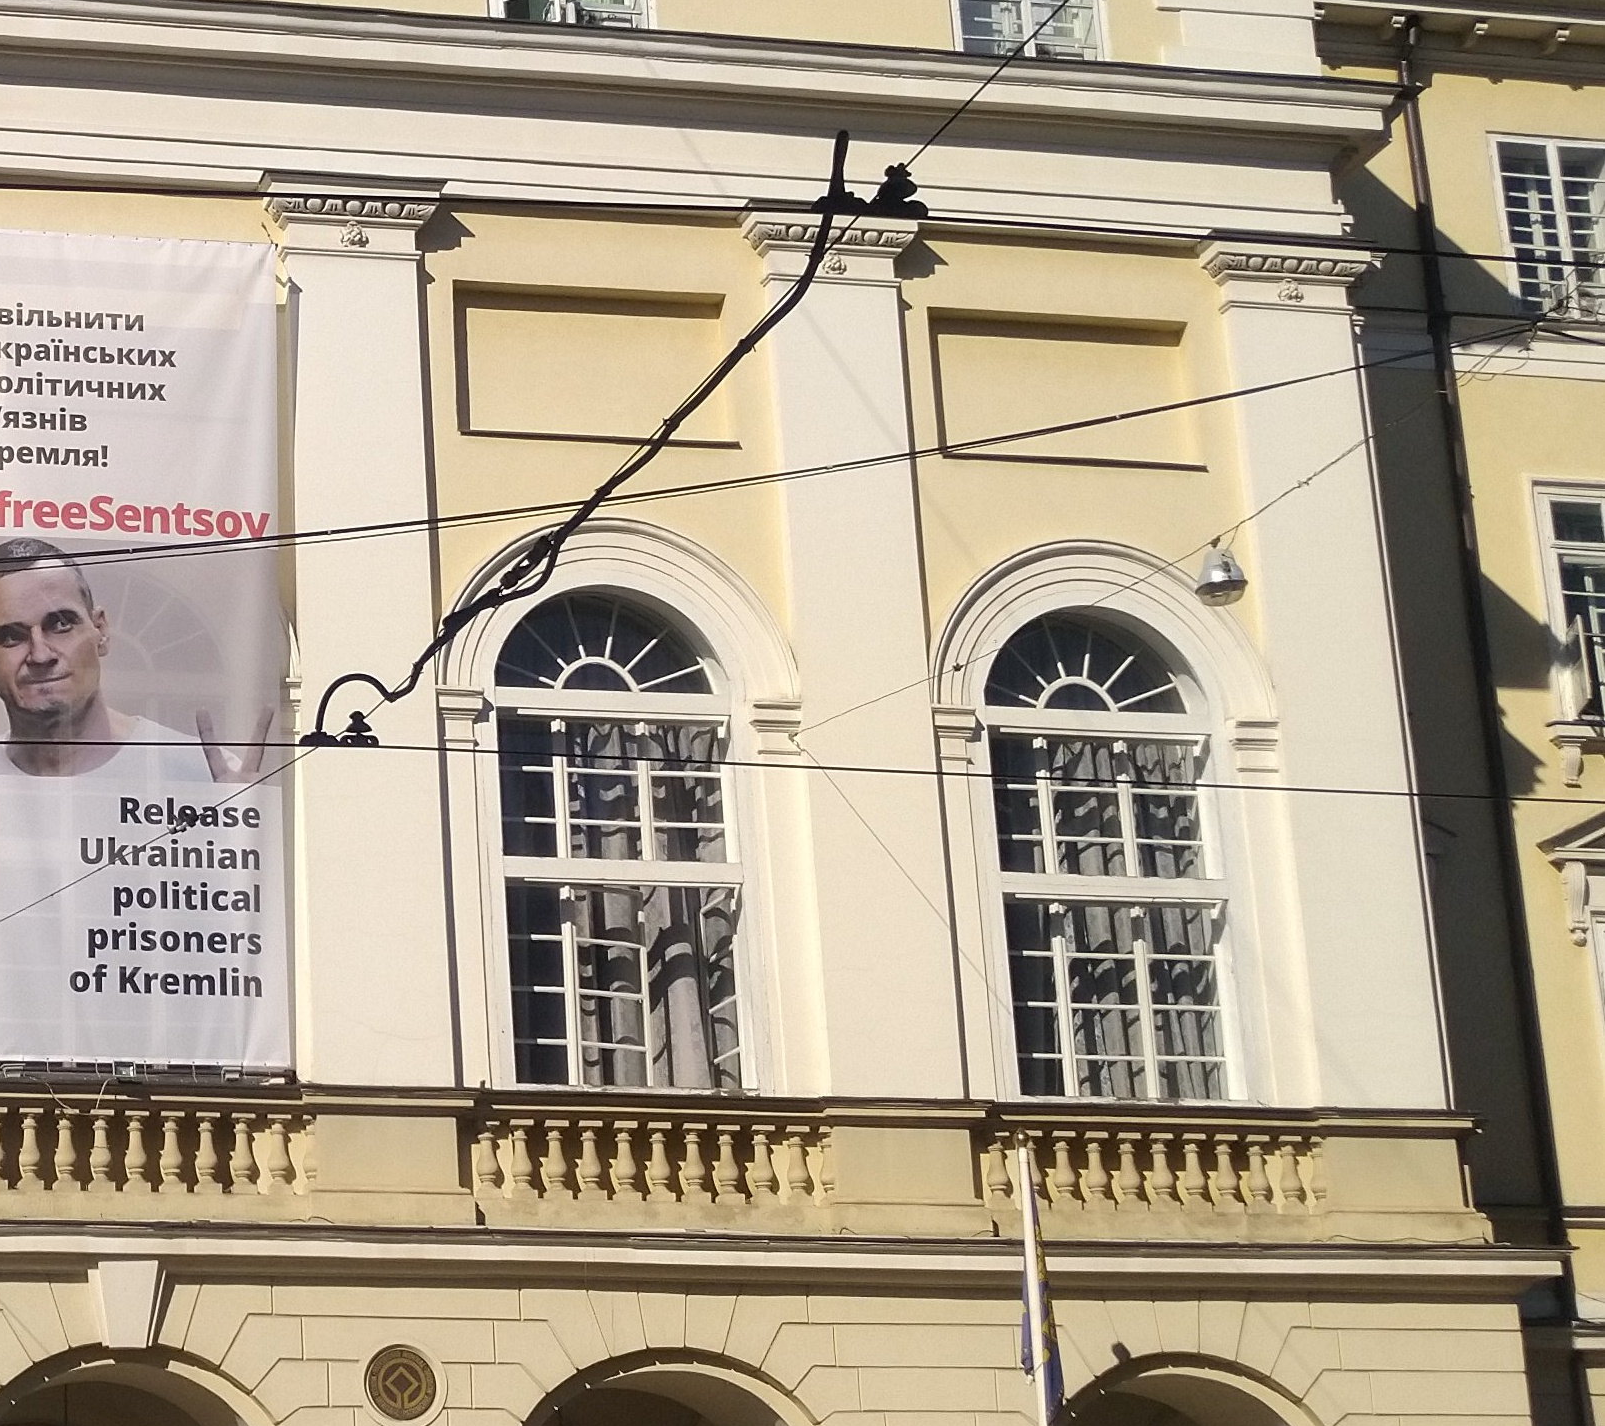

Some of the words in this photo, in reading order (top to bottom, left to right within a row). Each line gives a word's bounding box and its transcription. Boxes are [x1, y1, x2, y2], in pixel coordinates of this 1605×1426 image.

[119, 797, 261, 829] Release
[79, 837, 261, 871] Ukrainian
[113, 880, 262, 916] political
[87, 921, 262, 959] prisoners
[69, 964, 108, 993] of
[118, 965, 263, 998] Kremlin
